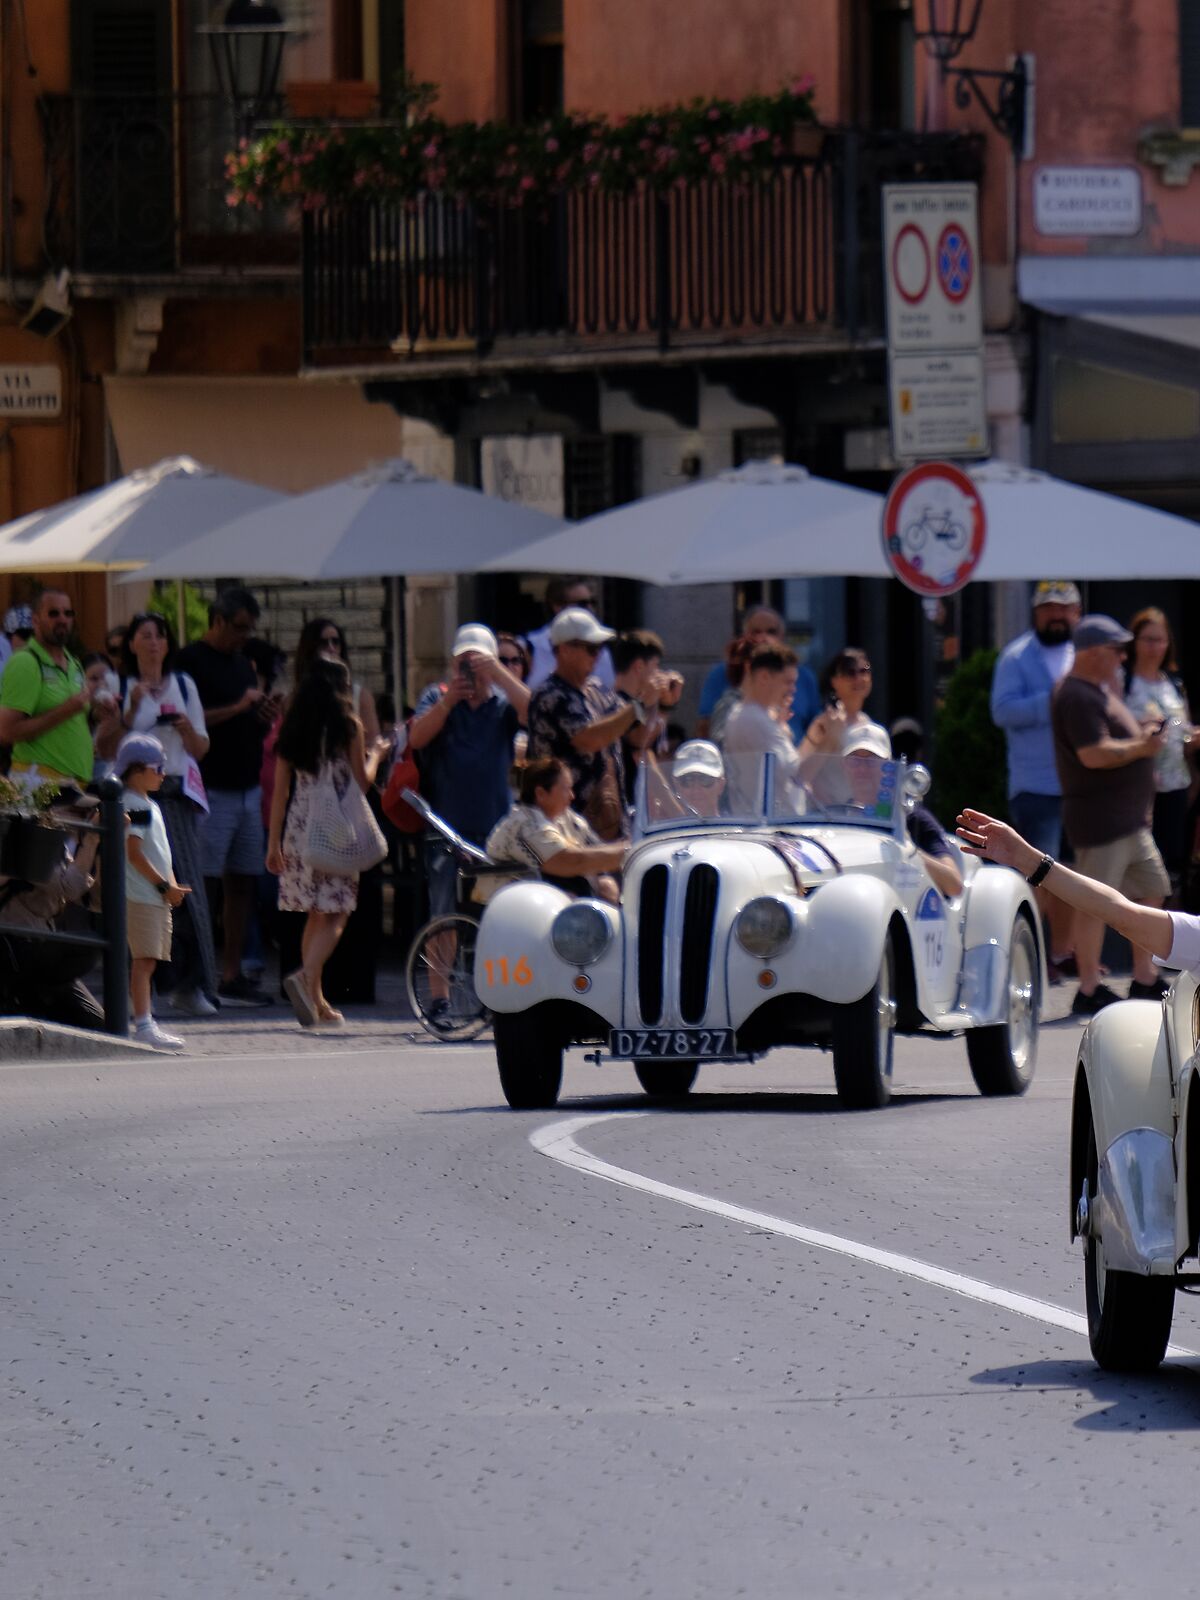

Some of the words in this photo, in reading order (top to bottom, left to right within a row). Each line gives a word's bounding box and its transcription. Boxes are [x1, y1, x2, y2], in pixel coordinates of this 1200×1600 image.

[4, 373, 32, 390] VIA
[924, 930, 944, 968] 116
[484, 955, 534, 989] 116
